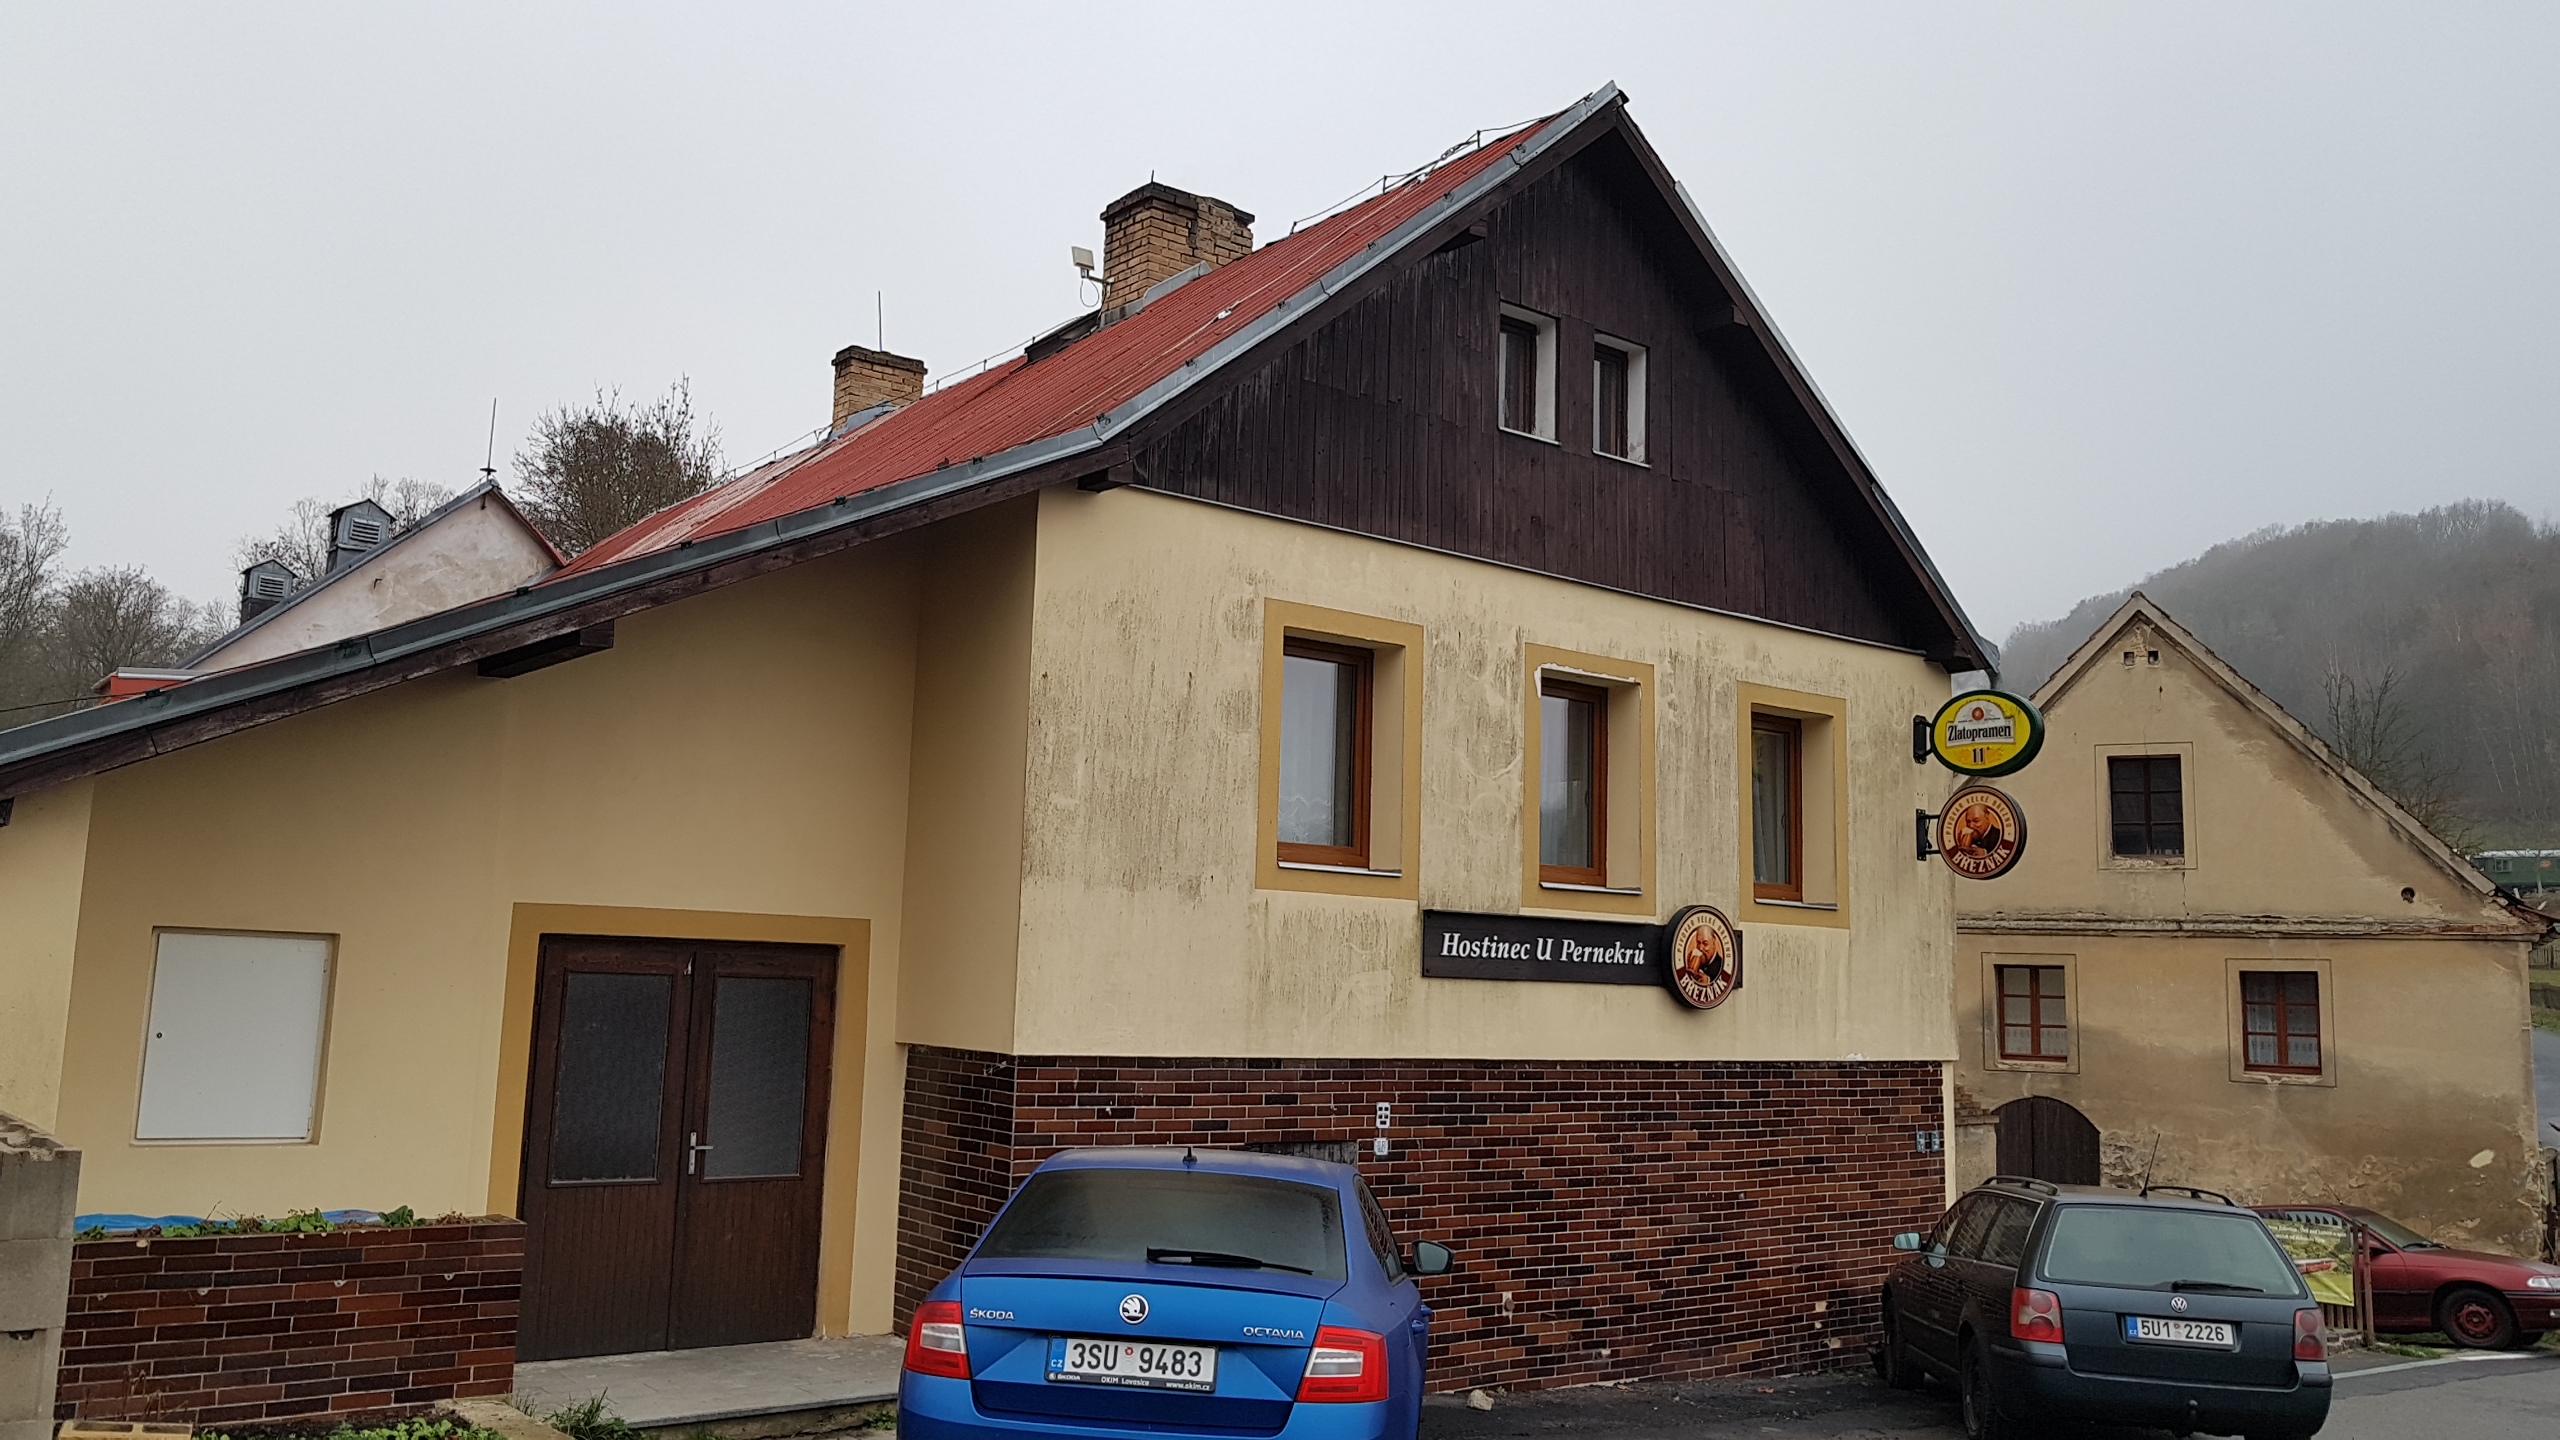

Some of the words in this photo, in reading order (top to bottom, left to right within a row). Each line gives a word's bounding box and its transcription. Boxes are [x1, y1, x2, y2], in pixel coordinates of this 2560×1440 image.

[1948, 724, 2012, 742] Zlatopramen
[1440, 932, 1530, 960] Hostinec
[1536, 937, 1554, 962] U
[1560, 939, 1645, 966] Pernekrů
[970, 1307, 1014, 1320] ŠKODA
[1243, 1326, 1304, 1340] OCTAVIA
[2141, 1320, 2170, 1338] 5U1
[2184, 1323, 2224, 1341] 2226
[1051, 1359, 1063, 1368] CZ
[1071, 1342, 1119, 1371] 3SU
[1138, 1346, 1202, 1377] 9483
[1101, 1376, 1119, 1384] OKIM
